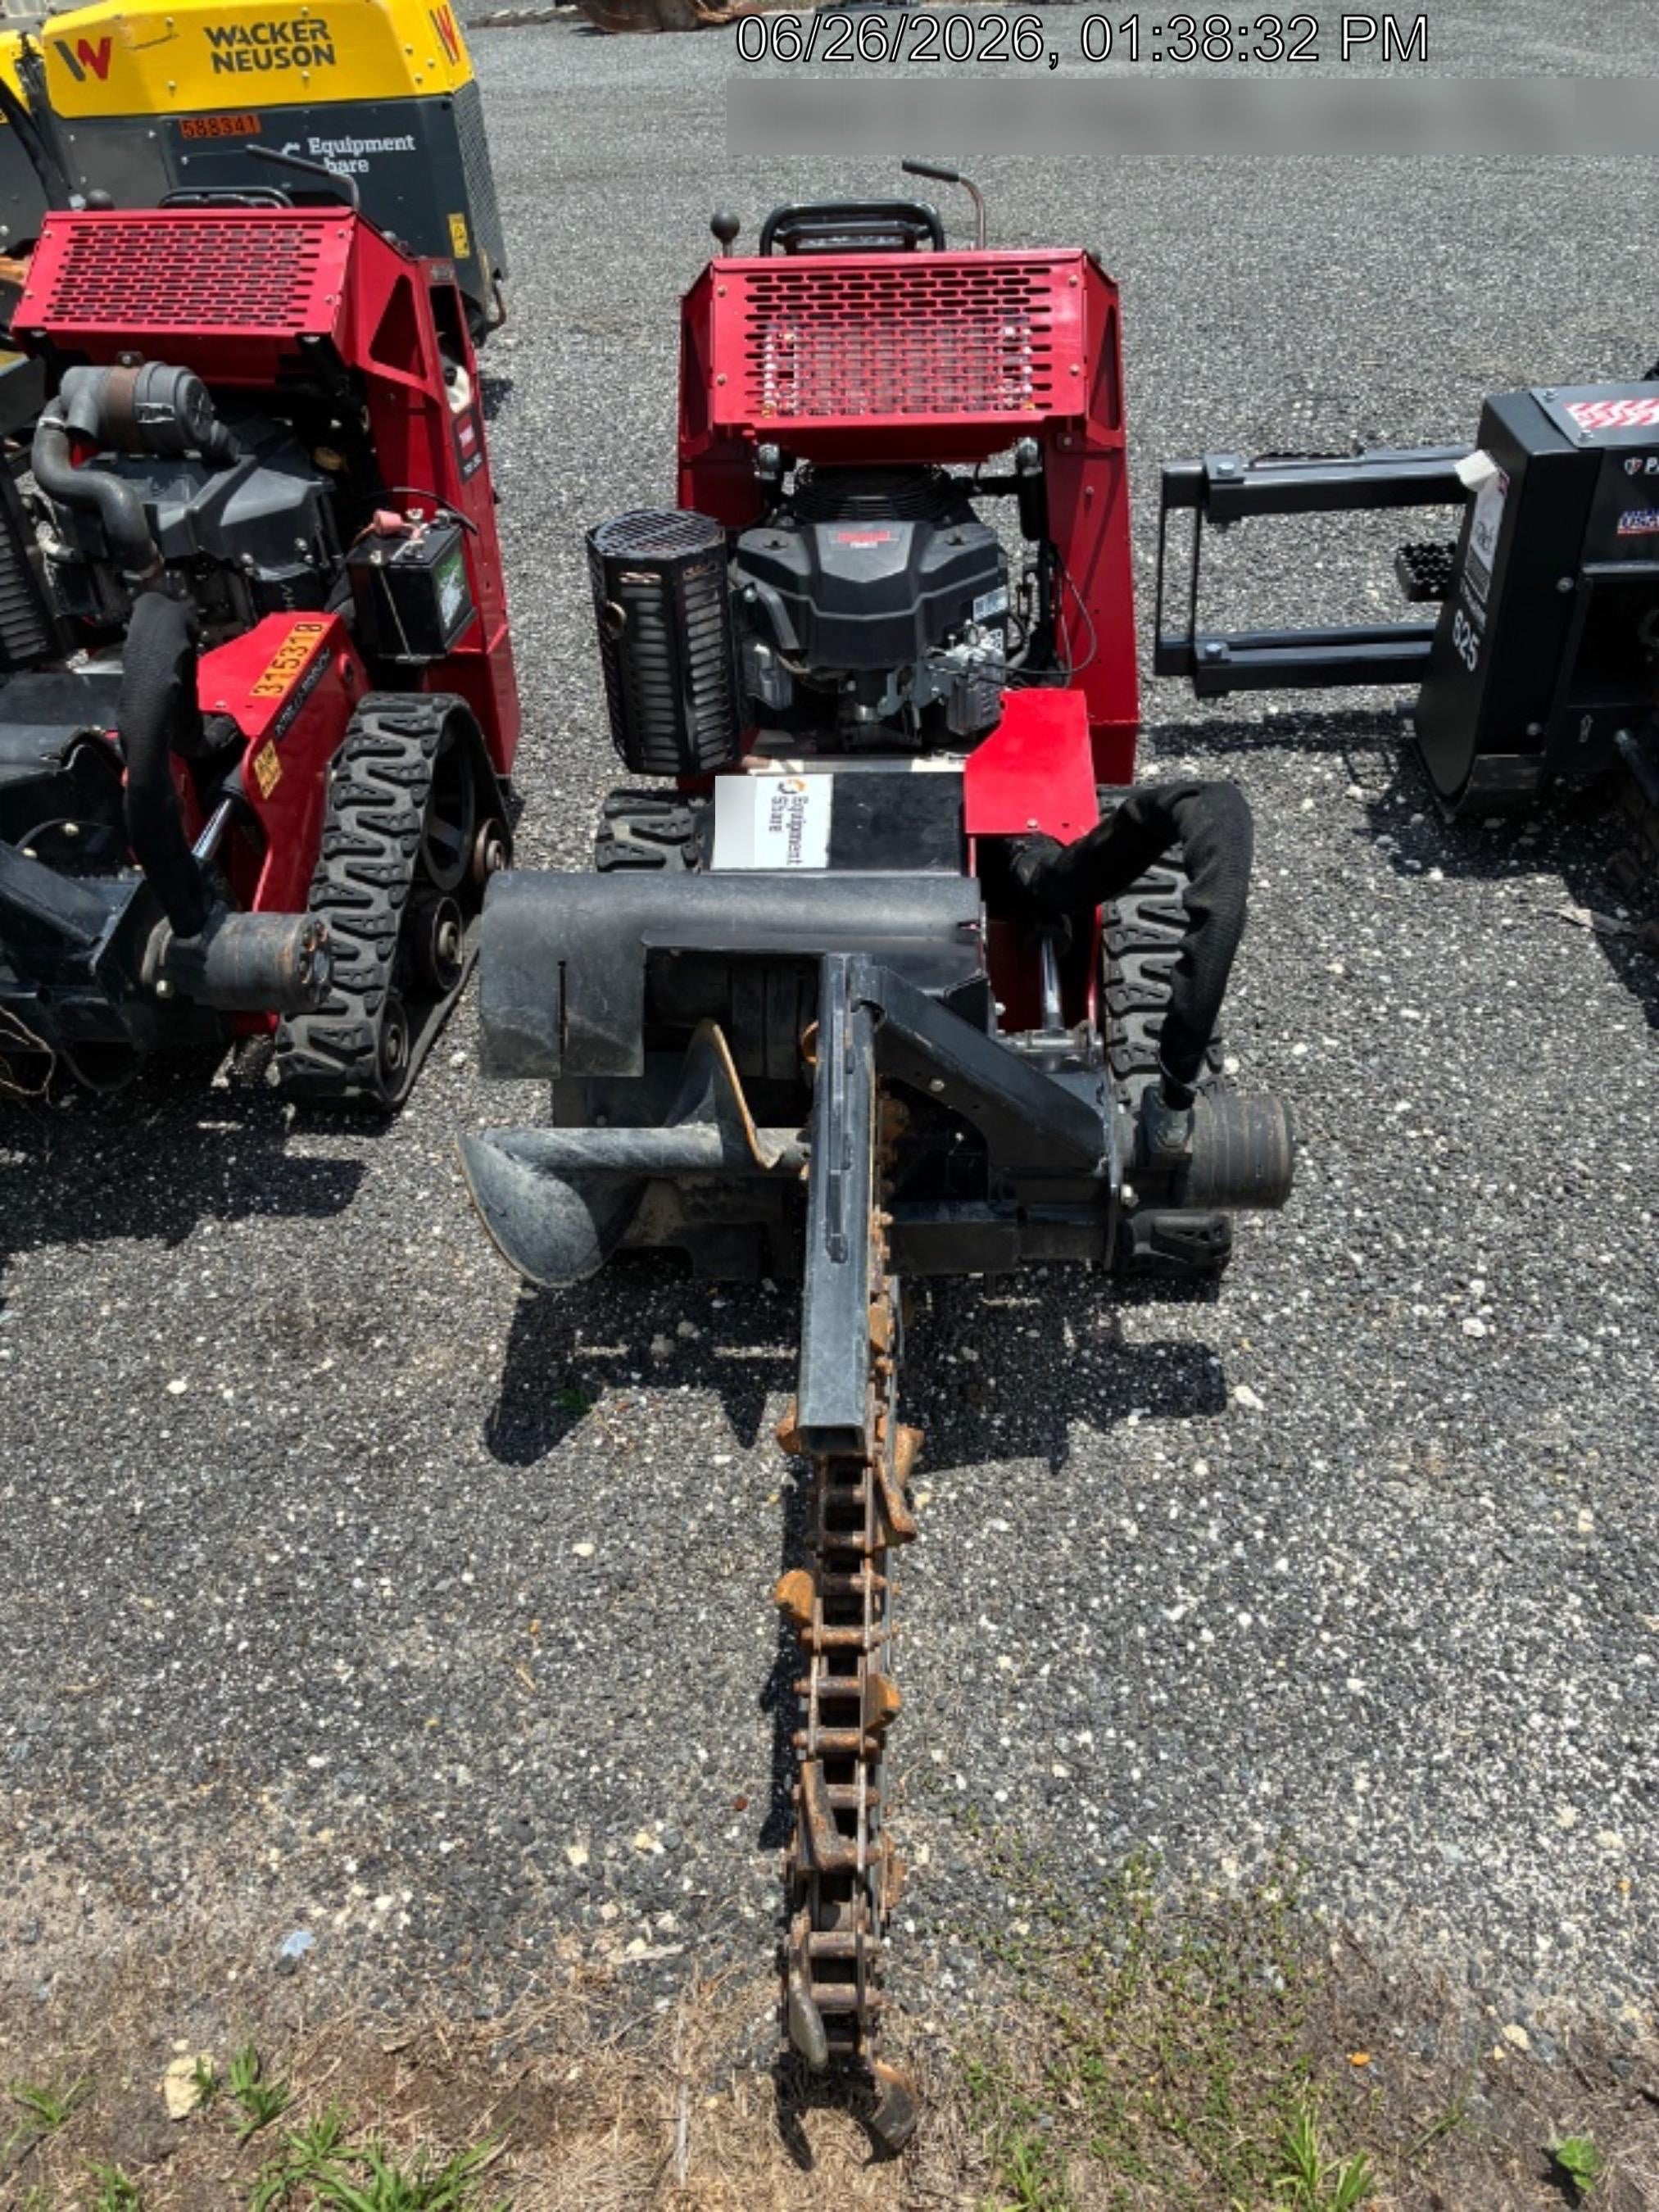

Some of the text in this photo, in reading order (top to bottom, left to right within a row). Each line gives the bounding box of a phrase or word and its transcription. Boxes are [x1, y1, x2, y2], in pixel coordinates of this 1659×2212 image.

[203, 19, 331, 48] WACKER
[211, 43, 337, 75] NEUSON
[307, 134, 416, 156] Equipment
[322, 156, 369, 173] hare
[768, 796, 788, 833] Share
[786, 796, 809, 866] Equipment
